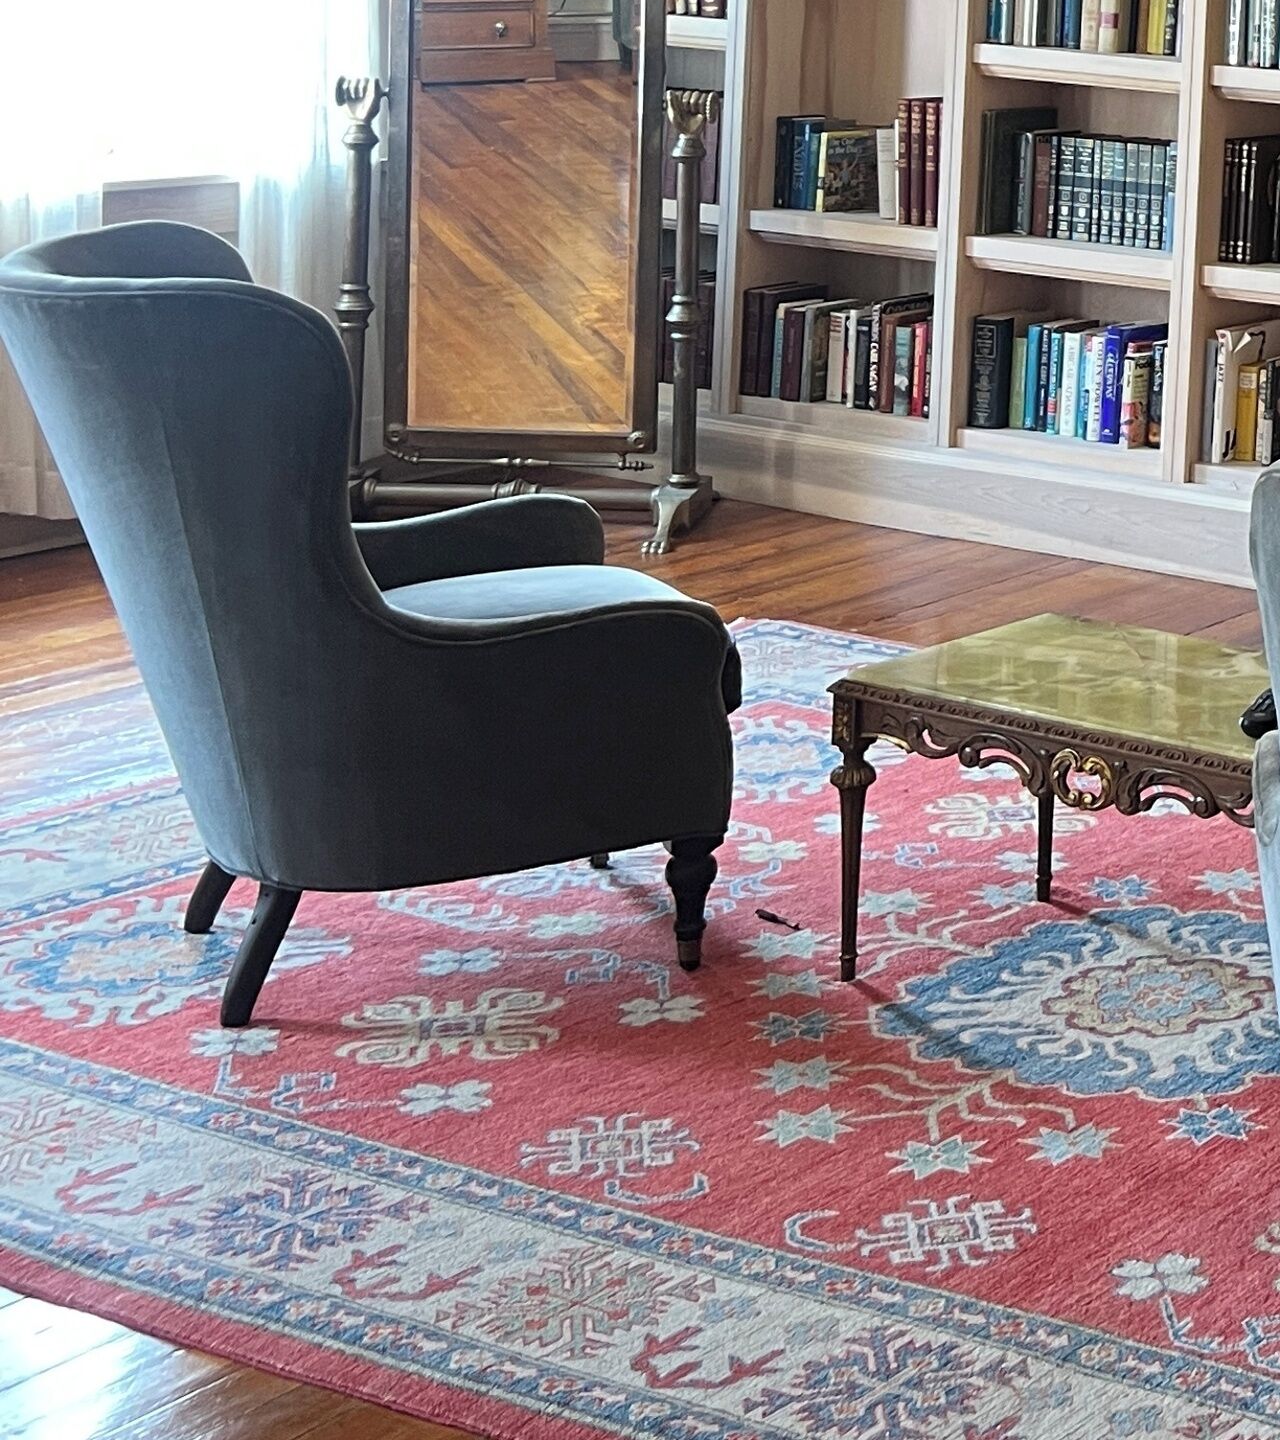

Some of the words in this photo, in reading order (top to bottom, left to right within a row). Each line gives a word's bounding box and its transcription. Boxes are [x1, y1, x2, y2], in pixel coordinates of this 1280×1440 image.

[792, 135, 805, 191] EXODUS
[1094, 340, 1104, 375] COLIN
[868, 364, 879, 393] SAGAN
[1092, 381, 1102, 424] POWELL
